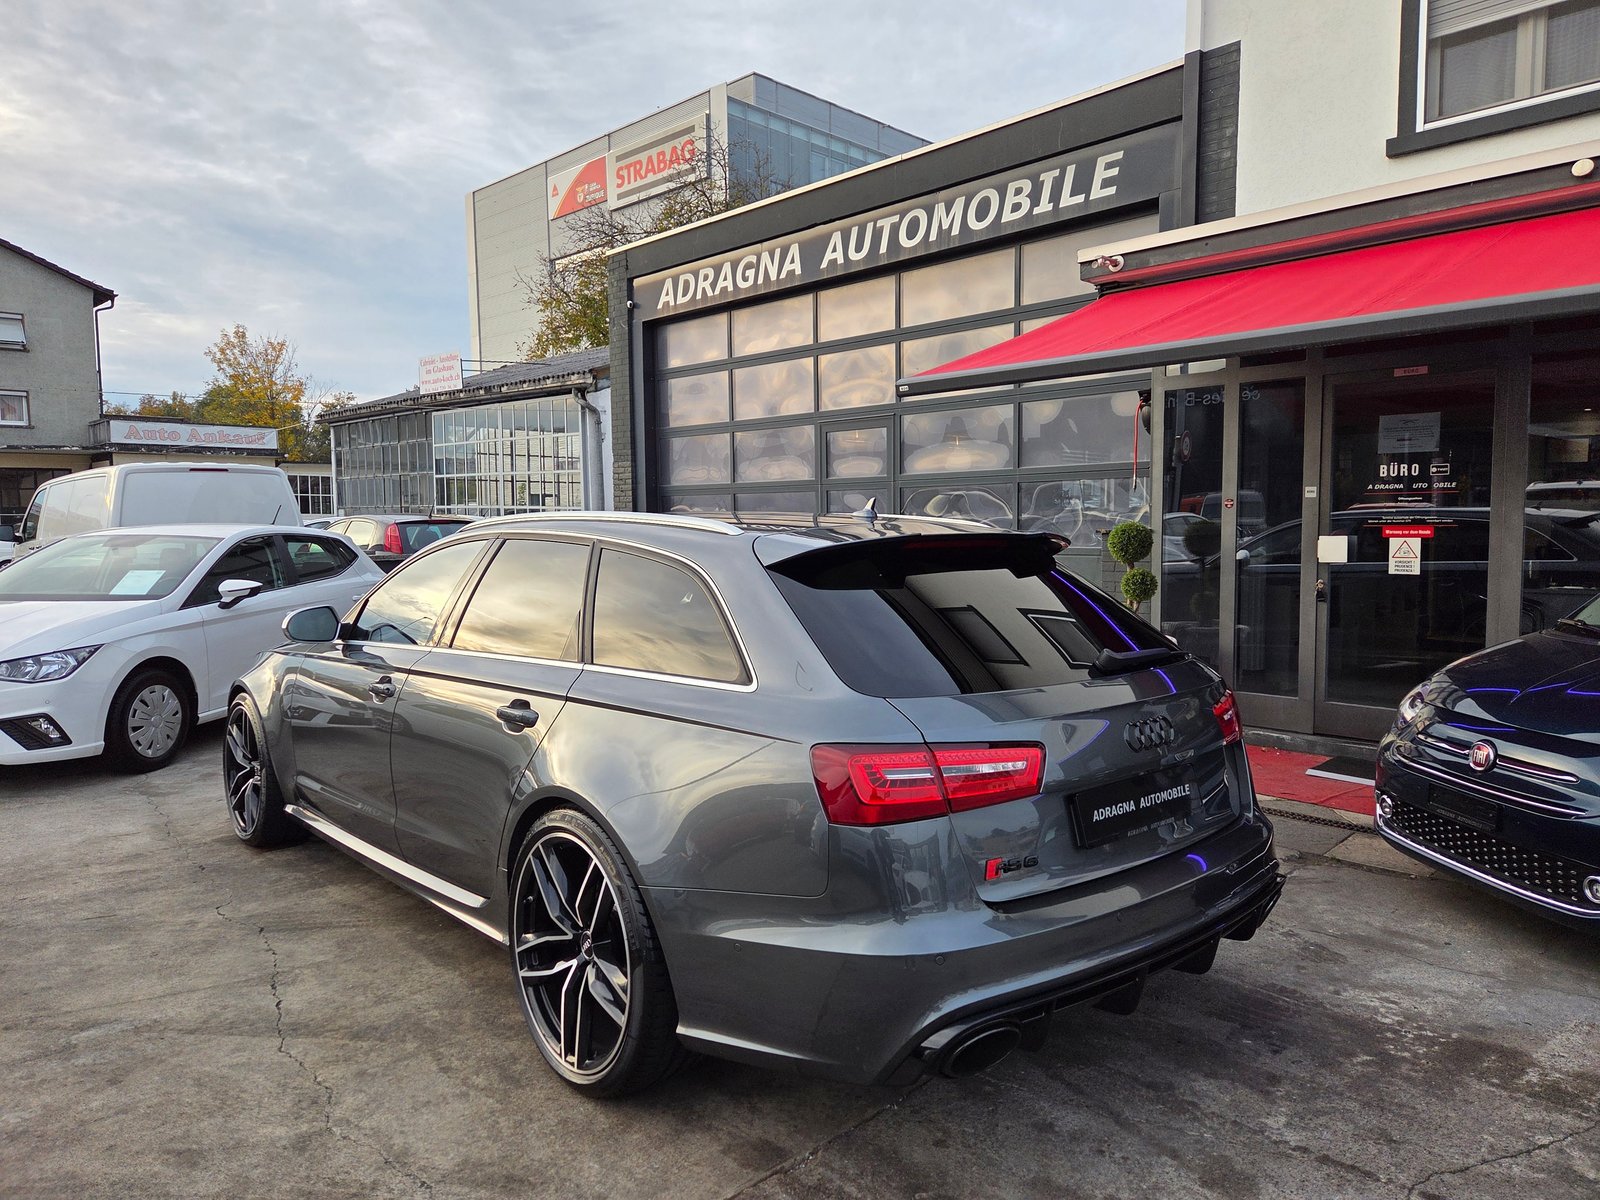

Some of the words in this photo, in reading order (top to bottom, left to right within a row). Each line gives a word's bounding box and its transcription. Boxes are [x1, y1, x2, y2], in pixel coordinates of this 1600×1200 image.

[616, 139, 696, 188] STRABAG
[657, 243, 802, 310] ADRAGNA
[820, 150, 1125, 269] AUTOMOBILE
[124, 424, 181, 441] Auto
[1379, 462, 1420, 477] BÜRO
[1473, 750, 1487, 764] FIAT
[1093, 800, 1136, 822] ADRAGNA
[1140, 784, 1190, 808] AUTOMOBILE
